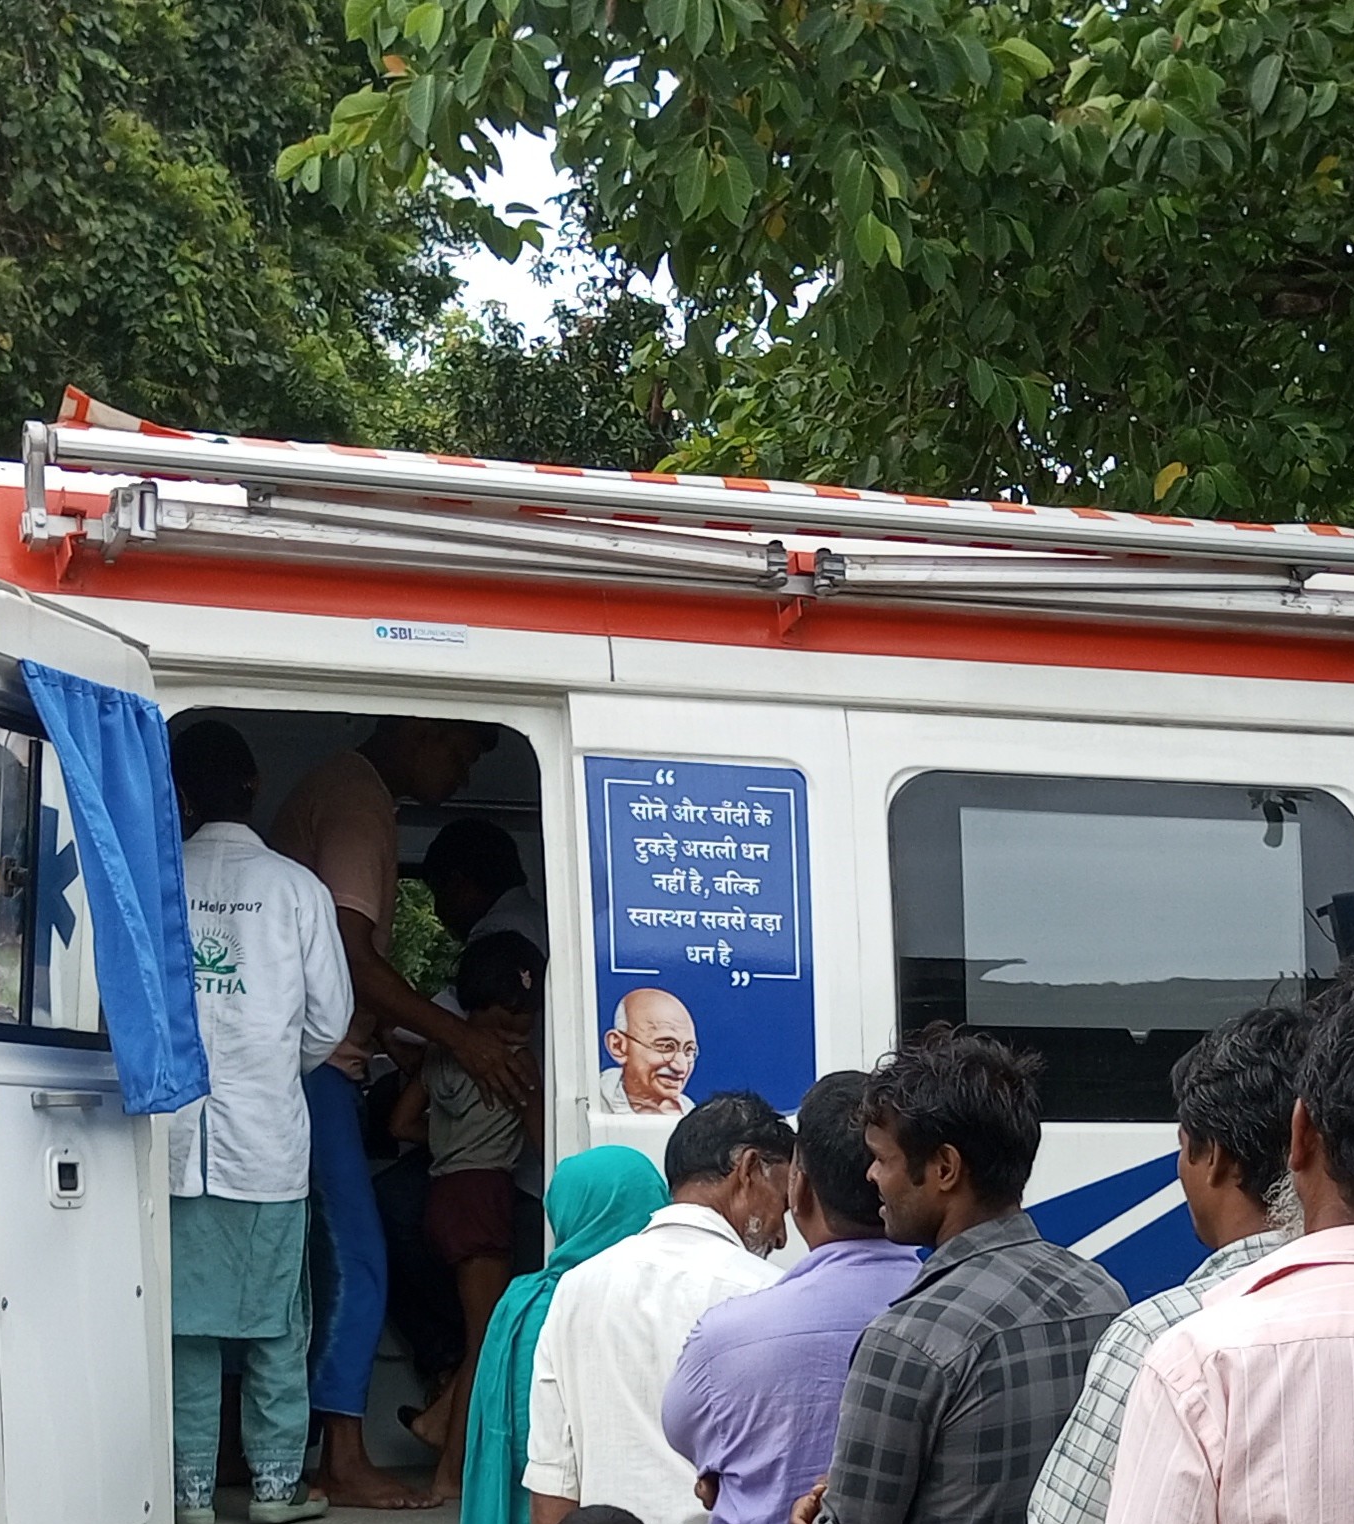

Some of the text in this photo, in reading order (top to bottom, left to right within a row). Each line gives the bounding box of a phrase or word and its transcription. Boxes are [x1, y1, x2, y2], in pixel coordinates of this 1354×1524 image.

[389, 627, 412, 640] SBI
[629, 795, 772, 827] सोने और चाँदी के
[634, 833, 770, 863] टुकड़े असली धन
[652, 868, 686, 893] नहीं
[689, 868, 710, 899] है,
[198, 900, 227, 915] Help
[229, 902, 263, 915] you?
[686, 939, 733, 967] धन है
[194, 976, 247, 995] STHA
